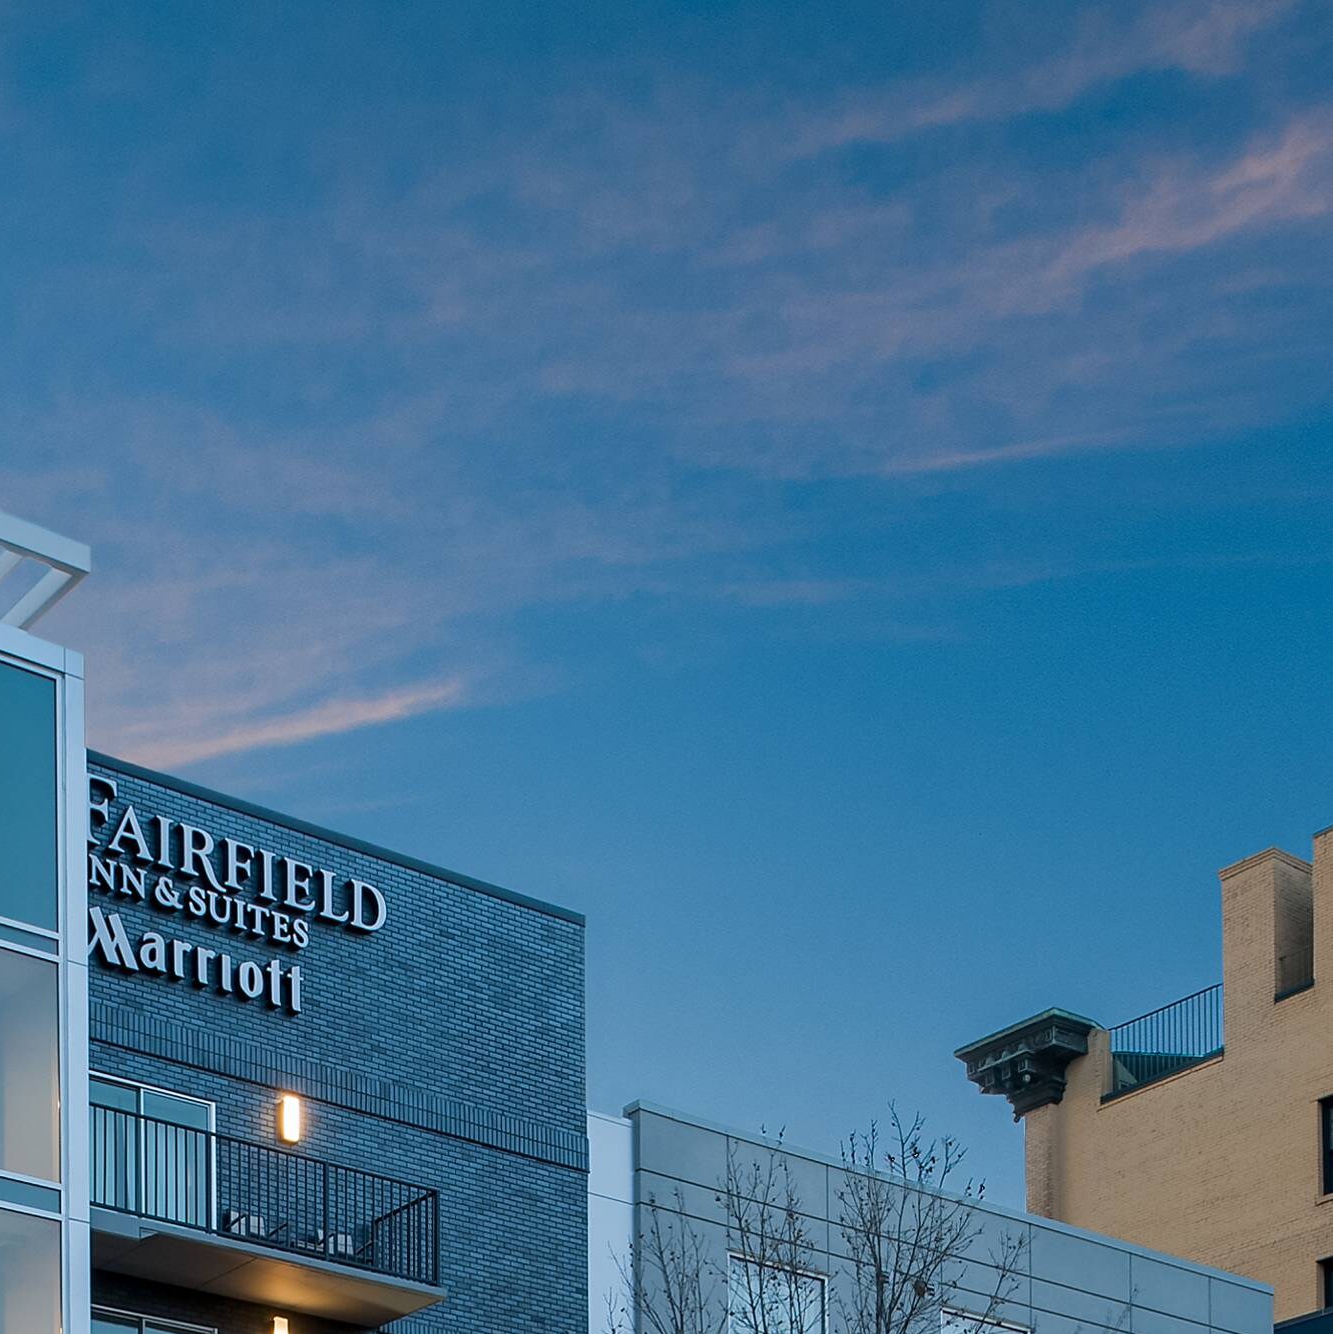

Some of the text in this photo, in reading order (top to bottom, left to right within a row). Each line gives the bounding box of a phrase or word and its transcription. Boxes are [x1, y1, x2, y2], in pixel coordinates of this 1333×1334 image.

[87, 774, 387, 932] FAIRFIELD
[89, 853, 310, 949] NN & SUITES
[88, 905, 304, 1013] Marriott
